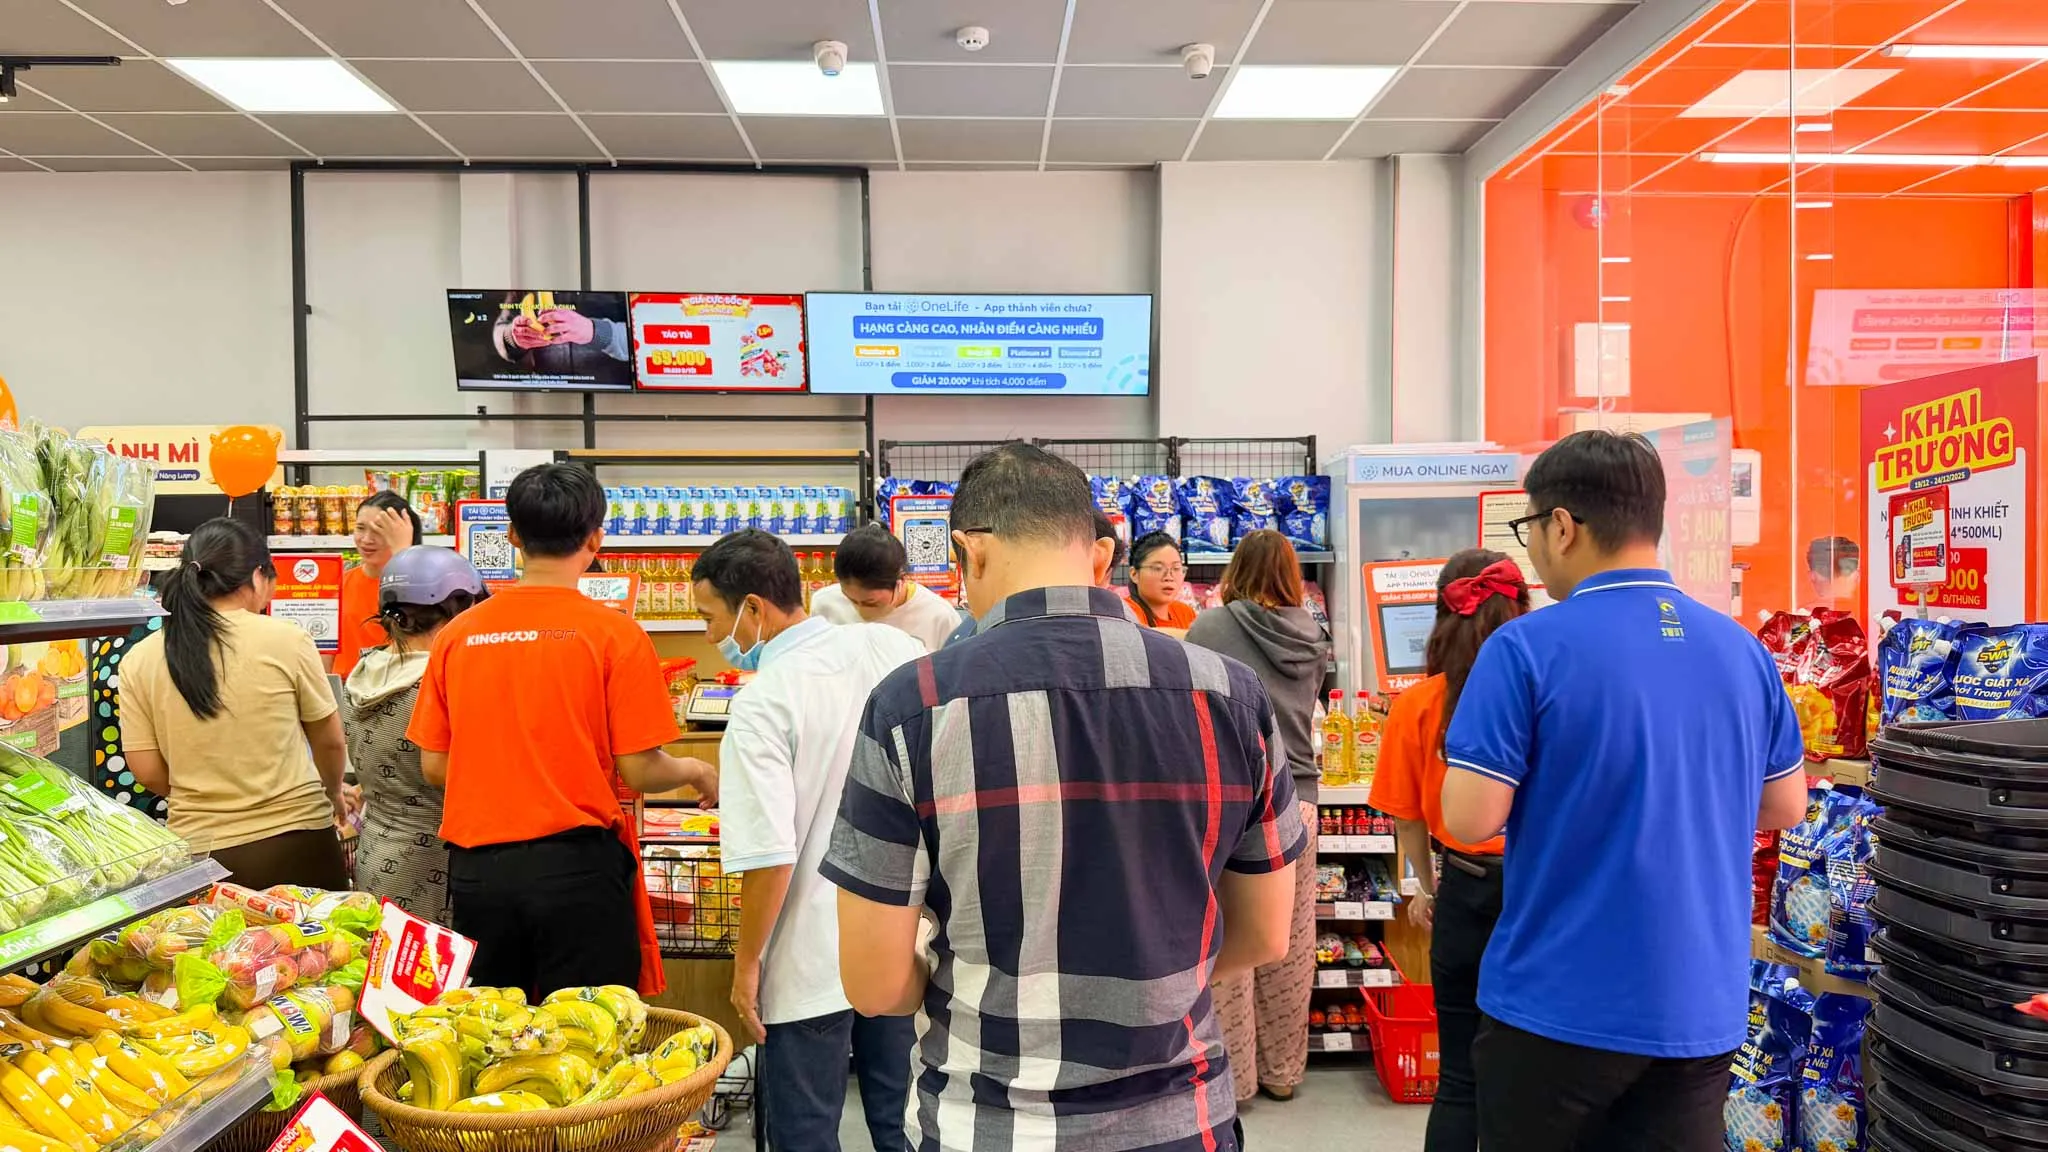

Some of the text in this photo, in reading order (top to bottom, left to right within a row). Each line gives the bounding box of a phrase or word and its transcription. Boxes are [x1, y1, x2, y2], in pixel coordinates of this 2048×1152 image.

[865, 302, 885, 312] Bạn
[888, 301, 901, 310] tải
[921, 300, 969, 312] OneLife
[984, 303, 1005, 314] App
[1008, 303, 1037, 312] thành
[1041, 303, 1061, 312] viên
[1064, 304, 1092, 312] chưa?
[860, 321, 1097, 335] HẠNG CÀNG CAO, NHÂN ĐIỂM CÀNG NHIỀU
[652, 349, 706, 366] 69.000
[911, 374, 936, 385] GIẢM
[972, 376, 984, 385] khi
[986, 376, 1000, 386] tích
[1002, 376, 1025, 386] 4.000
[1026, 376, 1046, 386] điểm
[1905, 393, 1978, 442] KHAI
[168, 437, 199, 463] MÌ
[1878, 422, 2010, 482] TRƯƠNG
[159, 472, 176, 481] Năng
[1382, 464, 1509, 477] MUA ONLINE NGAY
[1914, 479, 1930, 489] 19/12
[1908, 497, 1927, 513] KHAI
[1974, 500, 2009, 519] KHIẾT
[1943, 593, 1980, 605] Đ/THÙNG
[1954, 674, 1981, 686] ƯỚC
[1985, 677, 2012, 688] GIẶT
[1974, 687, 2002, 699] Trong
[272, 995, 313, 1033] WOW!
[1740, 1041, 1774, 1065] GIẶT XẢ
[1821, 1045, 1834, 1059] XẢ
[1732, 1051, 1752, 1068] rong
